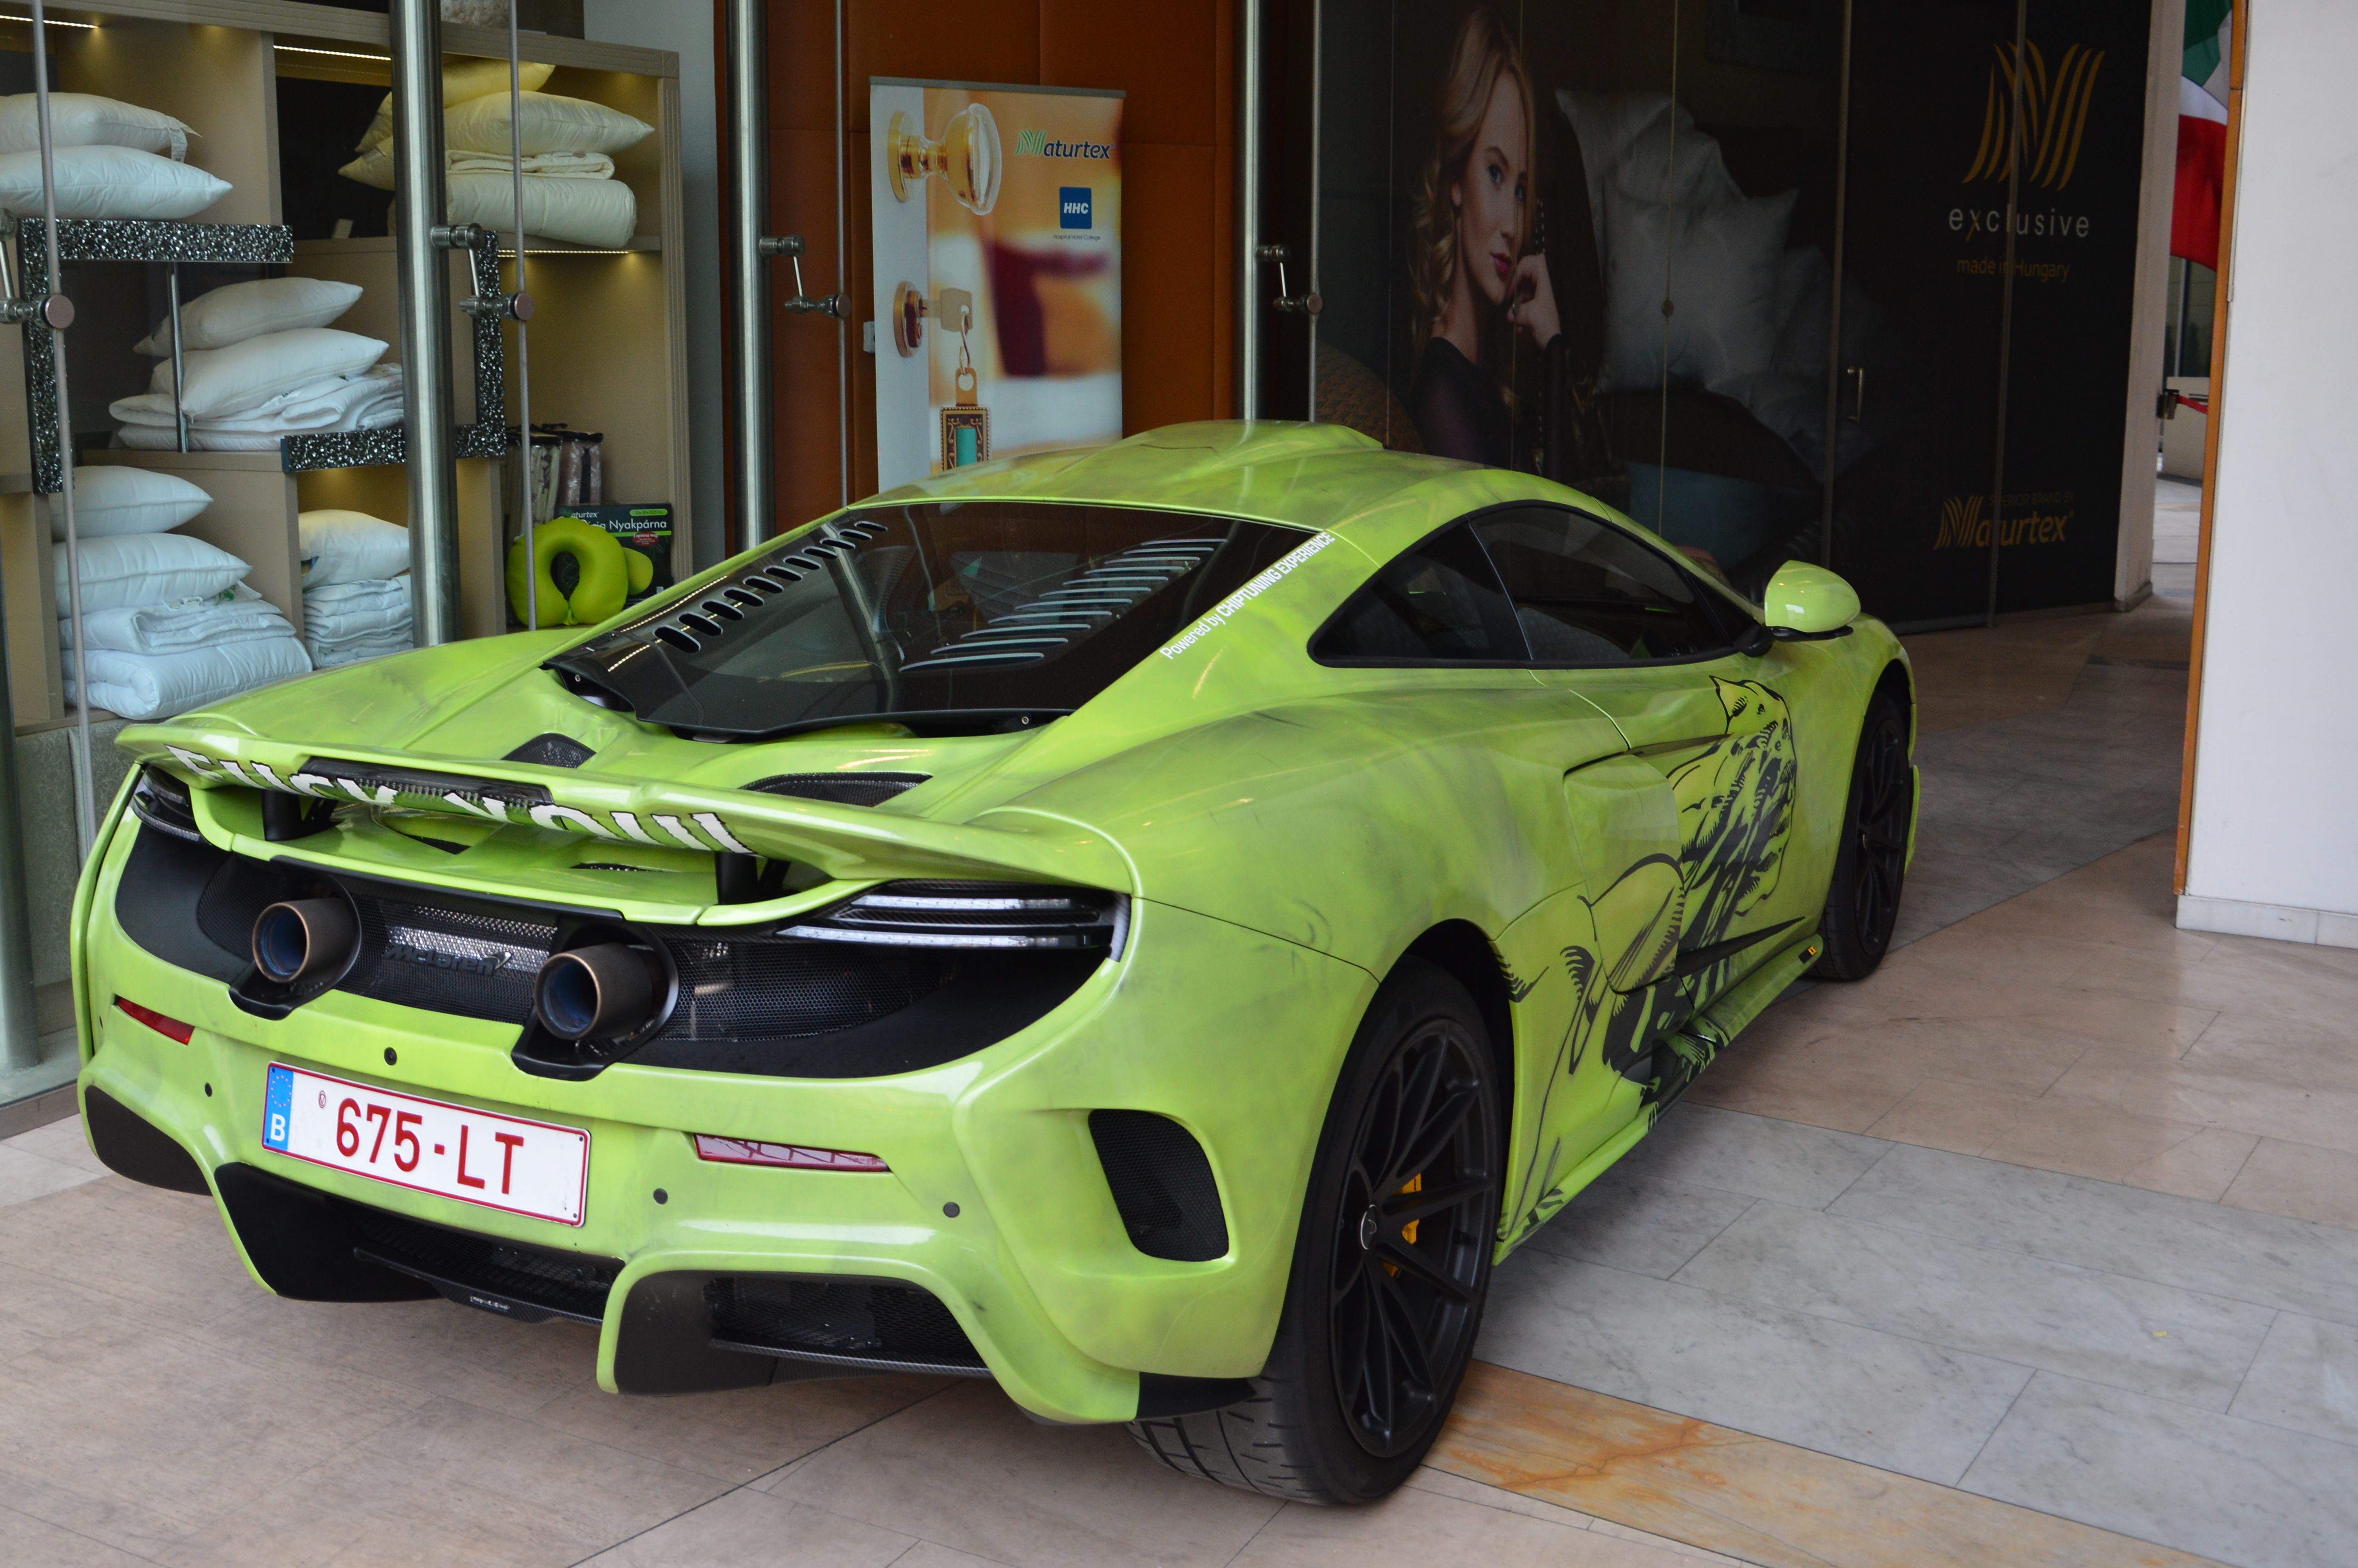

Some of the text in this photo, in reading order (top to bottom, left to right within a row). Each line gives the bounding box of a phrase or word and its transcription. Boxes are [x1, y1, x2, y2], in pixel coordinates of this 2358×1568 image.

[1064, 203, 1089, 214] HHC
[1956, 256, 1995, 274] made
[2013, 258, 2070, 283] Hungary
[609, 518, 667, 532] Nyakpárna
[1934, 495, 2066, 550] Naurtex
[1159, 531, 1336, 660] Powered by CHIPTUNING EXPERIENCE
[270, 1114, 286, 1142] B
